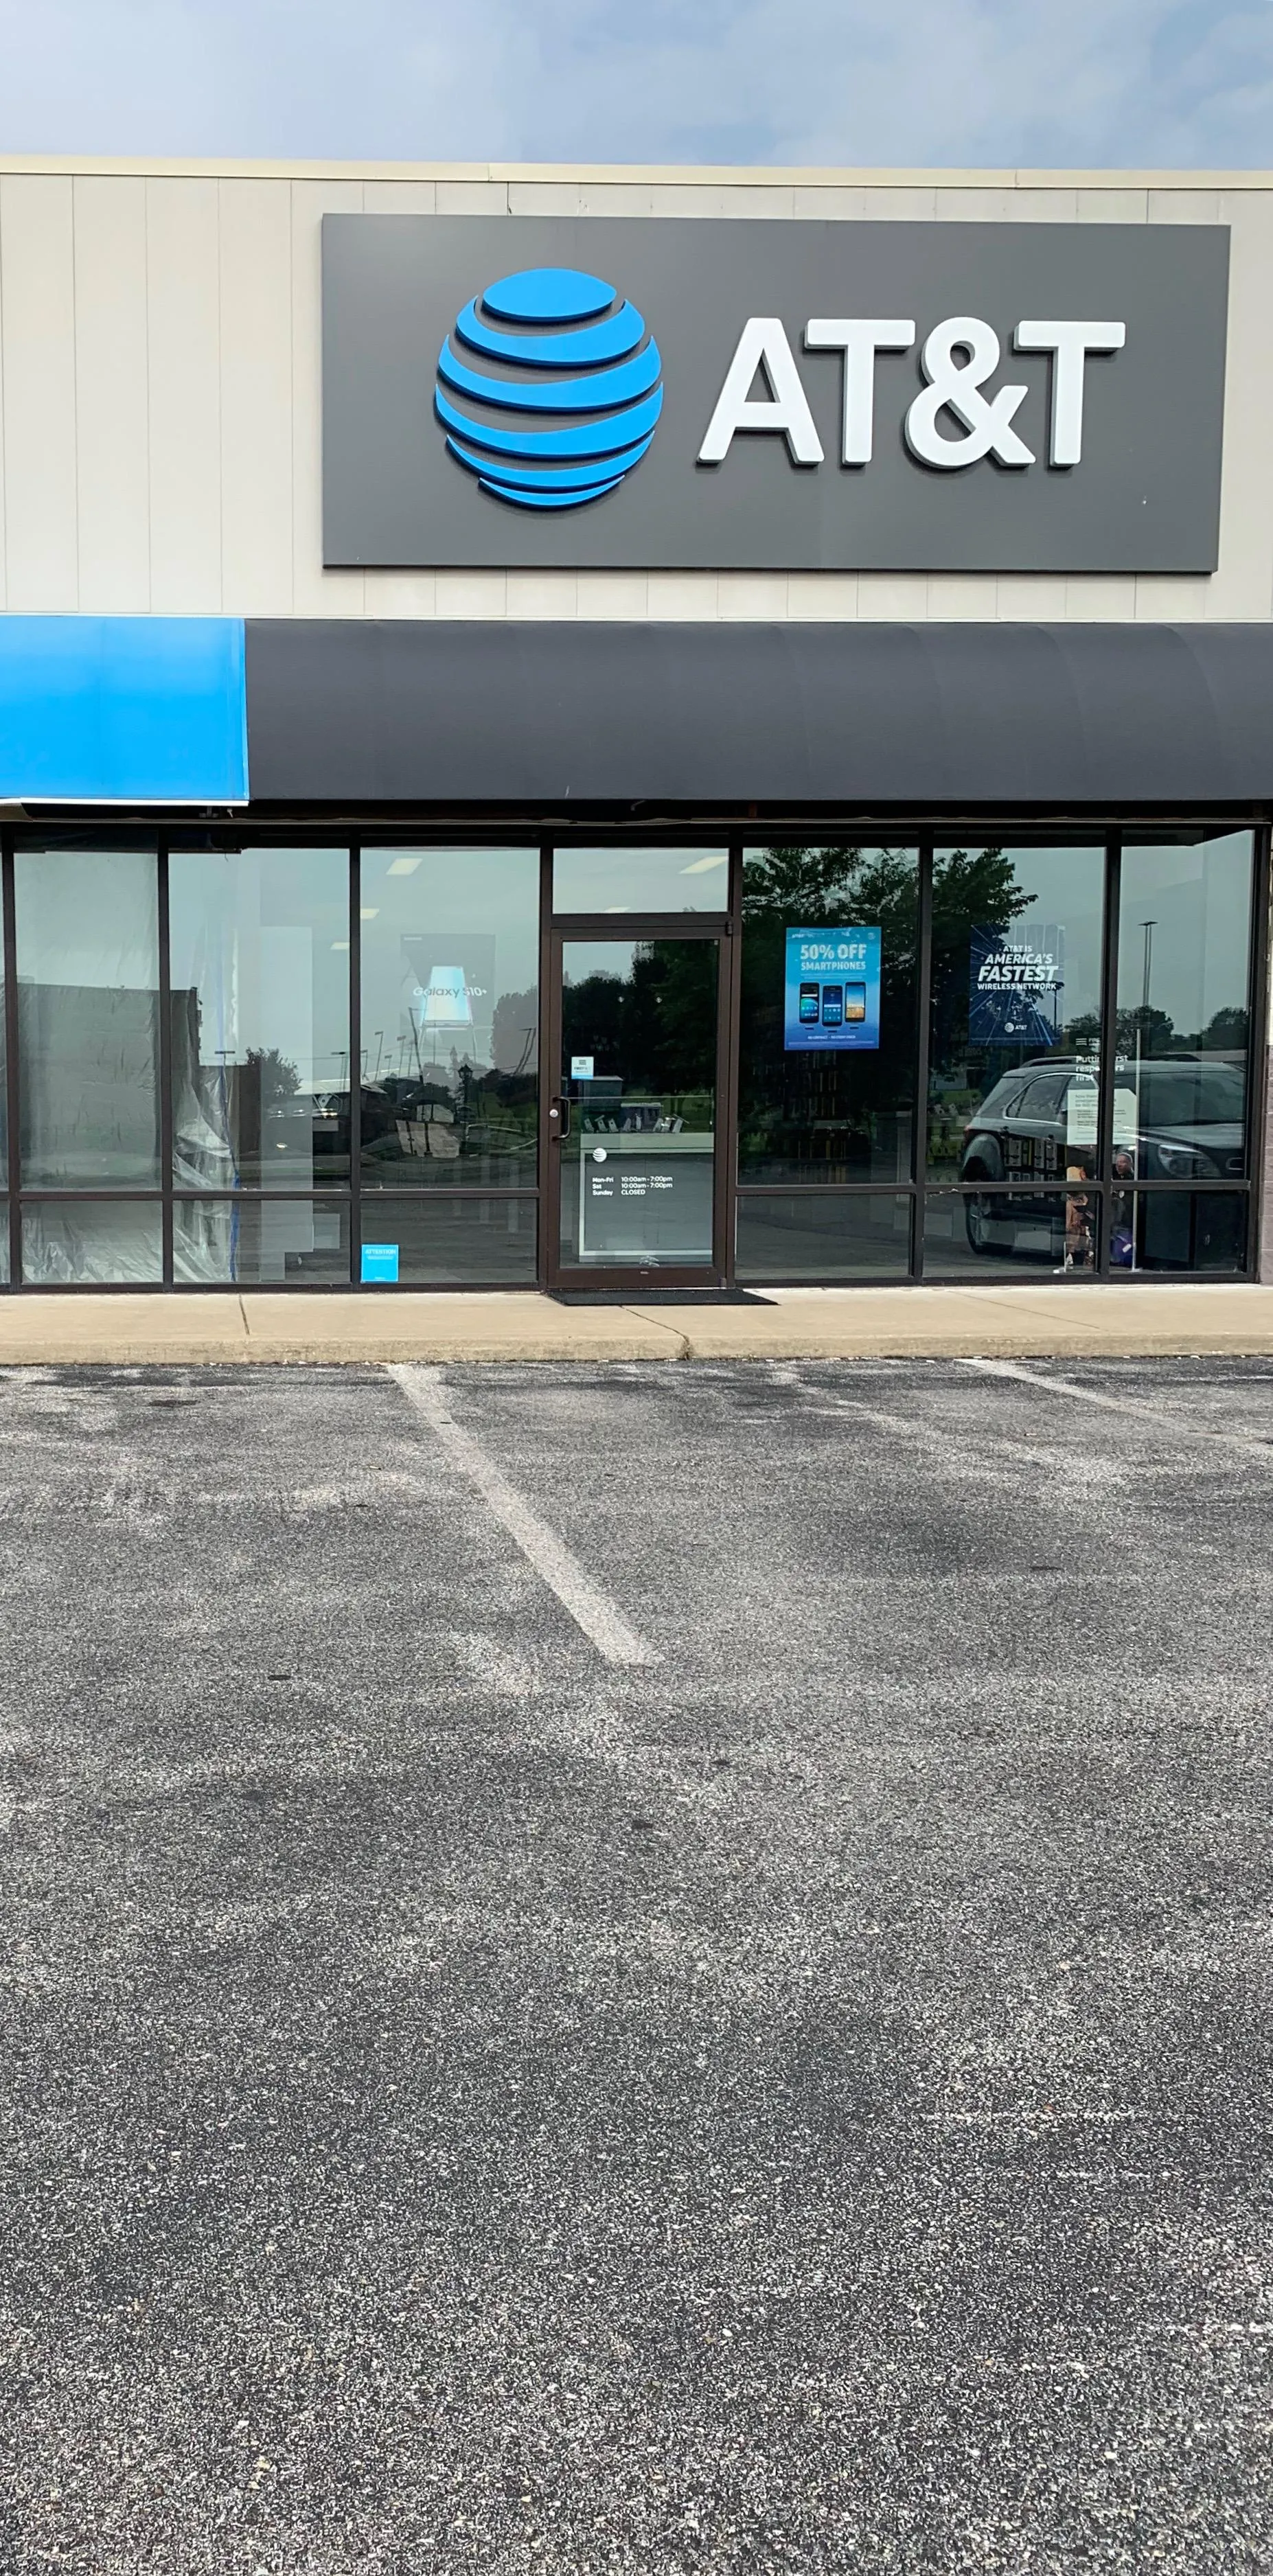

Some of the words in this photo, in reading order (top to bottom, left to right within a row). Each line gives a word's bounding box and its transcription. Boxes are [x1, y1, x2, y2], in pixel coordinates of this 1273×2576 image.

[696, 316, 1126, 470] AT&T
[800, 944, 835, 960] 50%
[838, 943, 867, 959] OFF
[801, 961, 867, 971] SMARTPHONES
[985, 953, 1053, 965] AMERICA'S
[978, 965, 1059, 982] FASTEST
[413, 987, 460, 998] Galaxy
[462, 987, 488, 997] S10+
